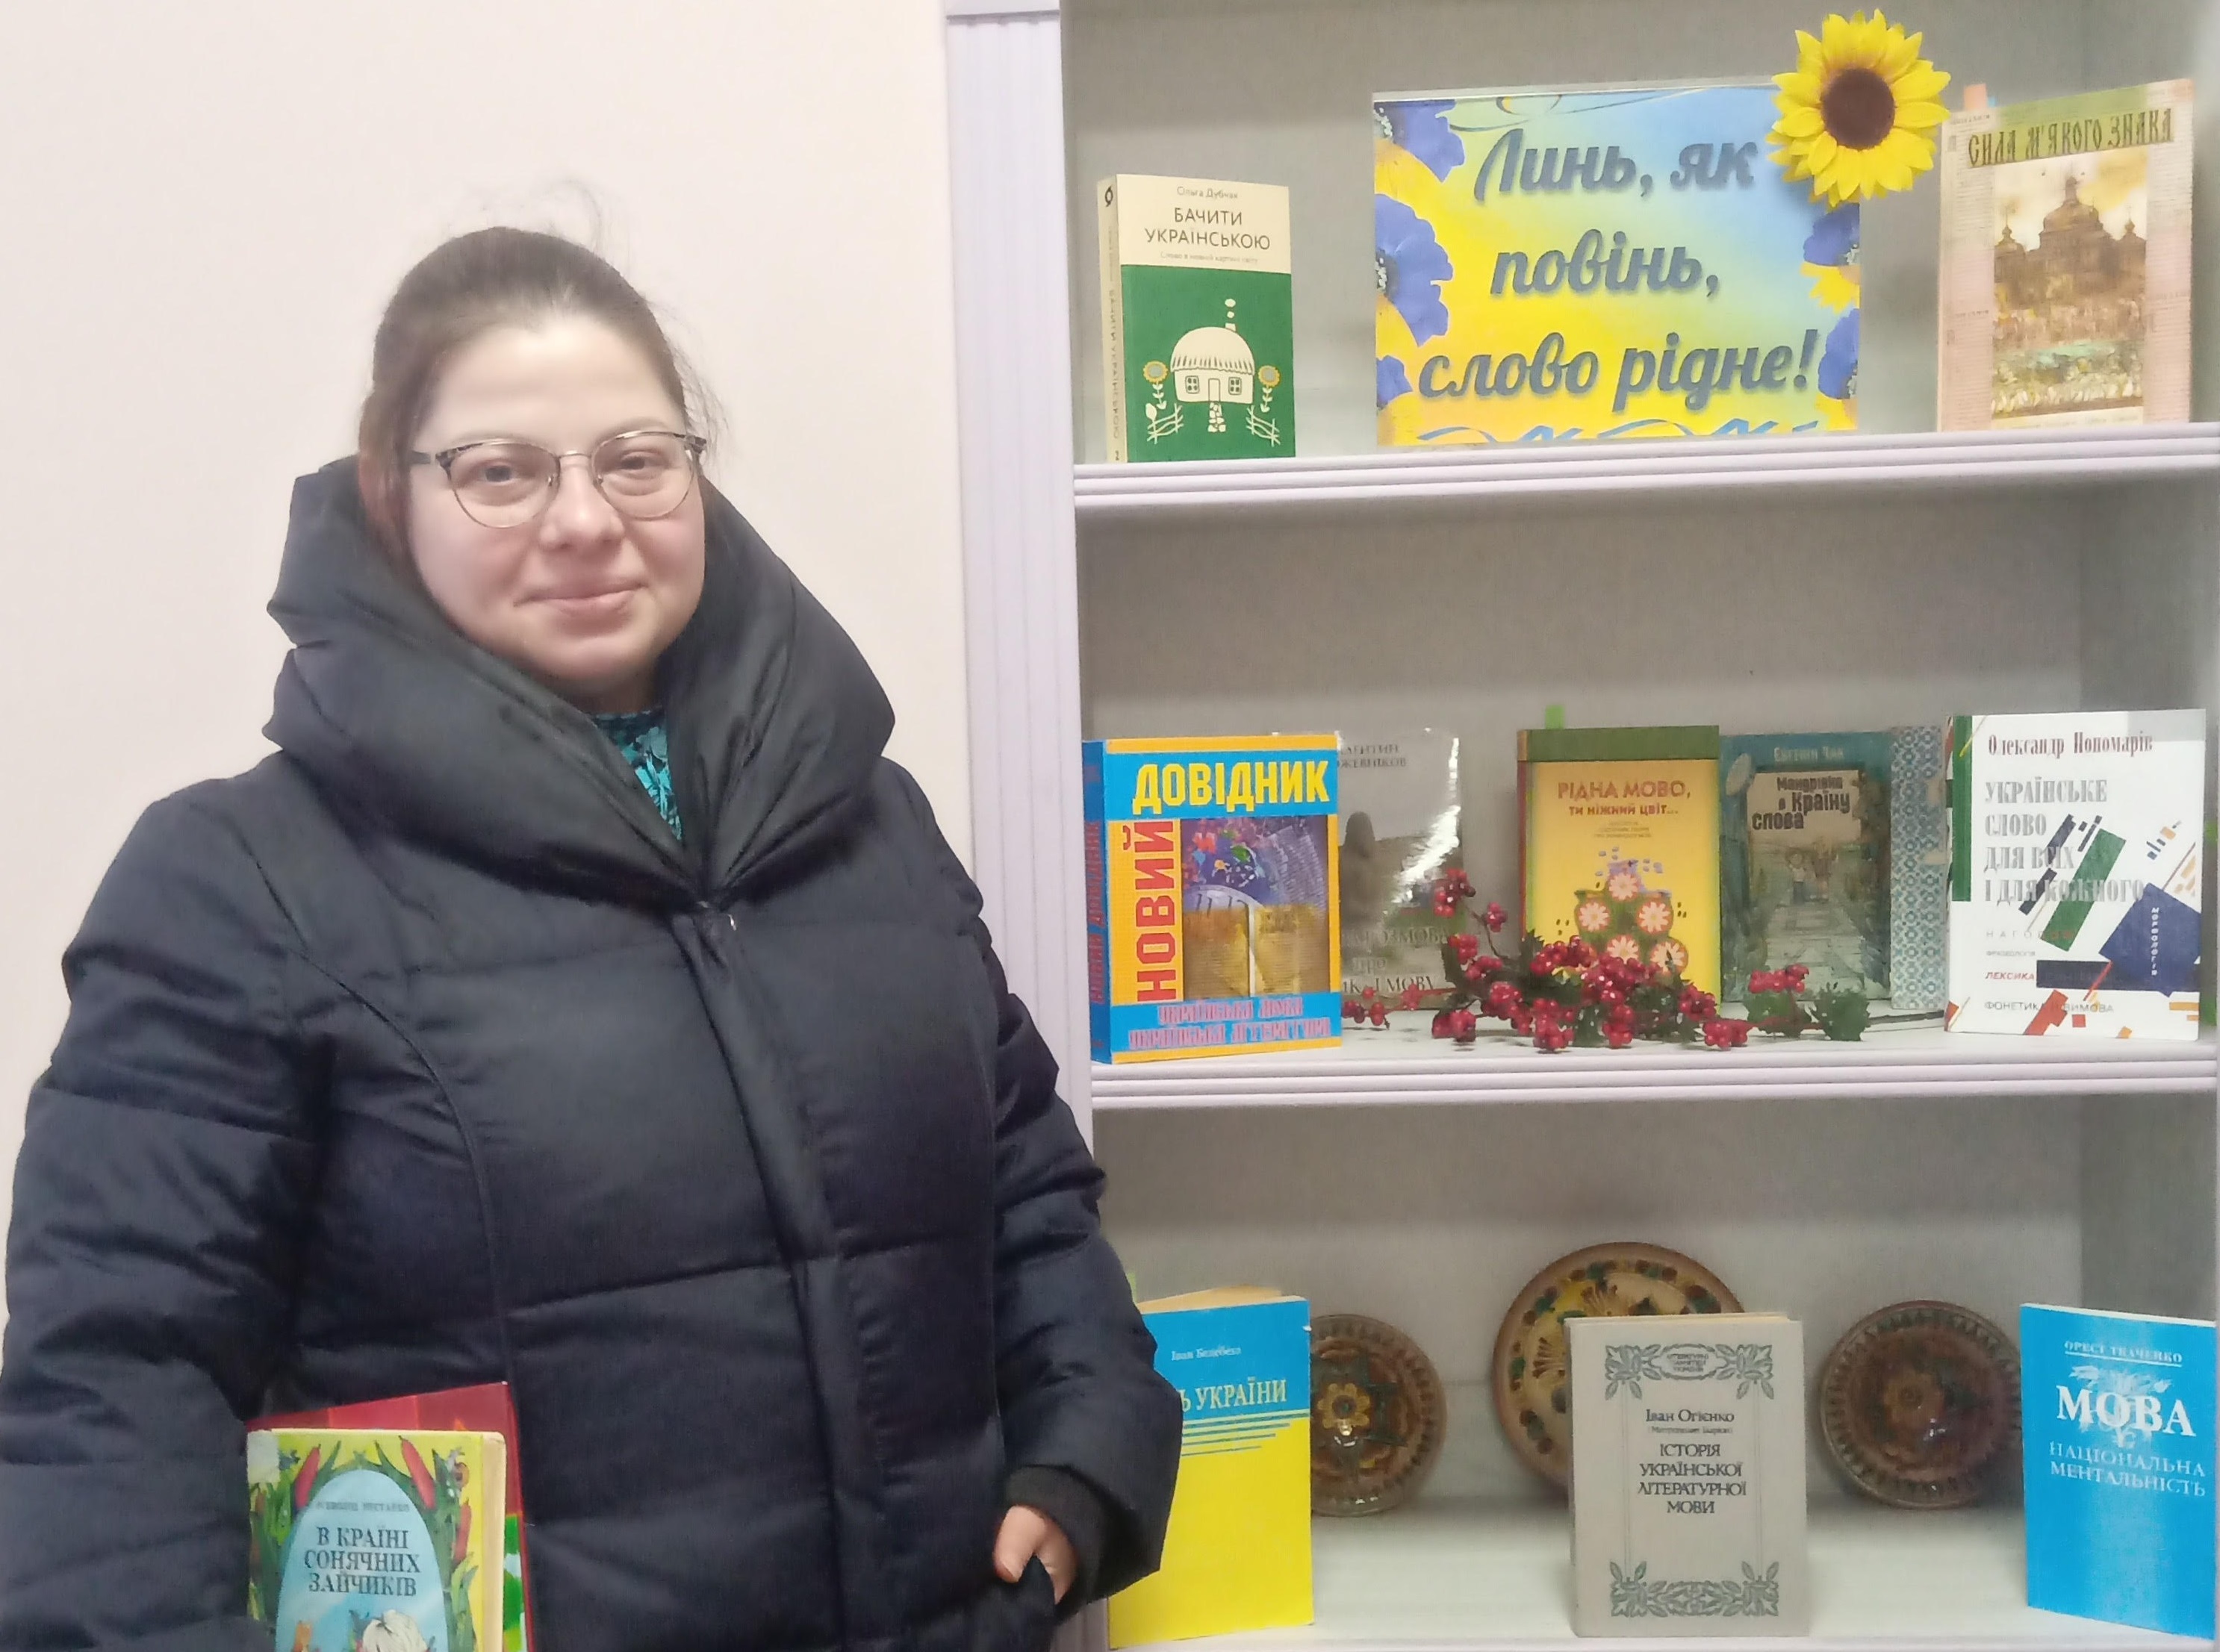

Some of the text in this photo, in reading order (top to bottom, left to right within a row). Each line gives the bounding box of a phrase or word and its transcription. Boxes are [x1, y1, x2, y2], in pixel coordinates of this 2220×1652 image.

[1473, 128, 1759, 202] Линь, як
[1177, 187, 1204, 196] Ольга
[1175, 208, 1242, 225] БАЧИТИ
[1145, 227, 1270, 250] УКРАЇНСЬКОЮ
[1490, 229, 1721, 297] повінь,
[1420, 329, 1819, 412] слово рідне!
[1989, 731, 2153, 758] Олександр Пономарів
[1132, 761, 1330, 815] ДОВІДНИК
[1558, 780, 1691, 801] РІДНА МОВО,
[1985, 776, 2106, 804] УКРАЇНСЬКЕ
[1569, 806, 1584, 816] ти
[1588, 802, 1635, 815] ніжний
[1985, 814, 2047, 837] СЛОВО
[1983, 847, 2075, 873] ДЛЯ ВСІХ
[1985, 879, 2144, 906] І ДЛЯ КОЖНОГО
[1123, 820, 1177, 1002] НОВИЙ
[2151, 907, 2160, 976] МОРФОЛОГІЯ
[1985, 972, 2035, 980] ЛЕКСИКА
[1195, 1376, 1287, 1410] УКРАЇНИ
[1646, 1409, 1735, 1422] Іван Огієнко
[2056, 1385, 2196, 1437] МОВА
[1660, 1444, 1720, 1457] ІСТОРІЯ
[2050, 1441, 2206, 1477] НАЦІОНАЛЬНА
[1640, 1460, 1744, 1477] УКРАЇНСЬКОЇ
[2050, 1461, 2207, 1497] МЕНТАЛЬНІСТЬ
[1638, 1480, 1747, 1496] ЛІТЕРАТУРНОЇ
[1667, 1500, 1715, 1514] МОВИ
[317, 1524, 408, 1549] В КРАЇНІ
[304, 1550, 420, 1573] СОНЯЧНИХ
[308, 1571, 417, 1597] ЗАЙЧИКІВ
